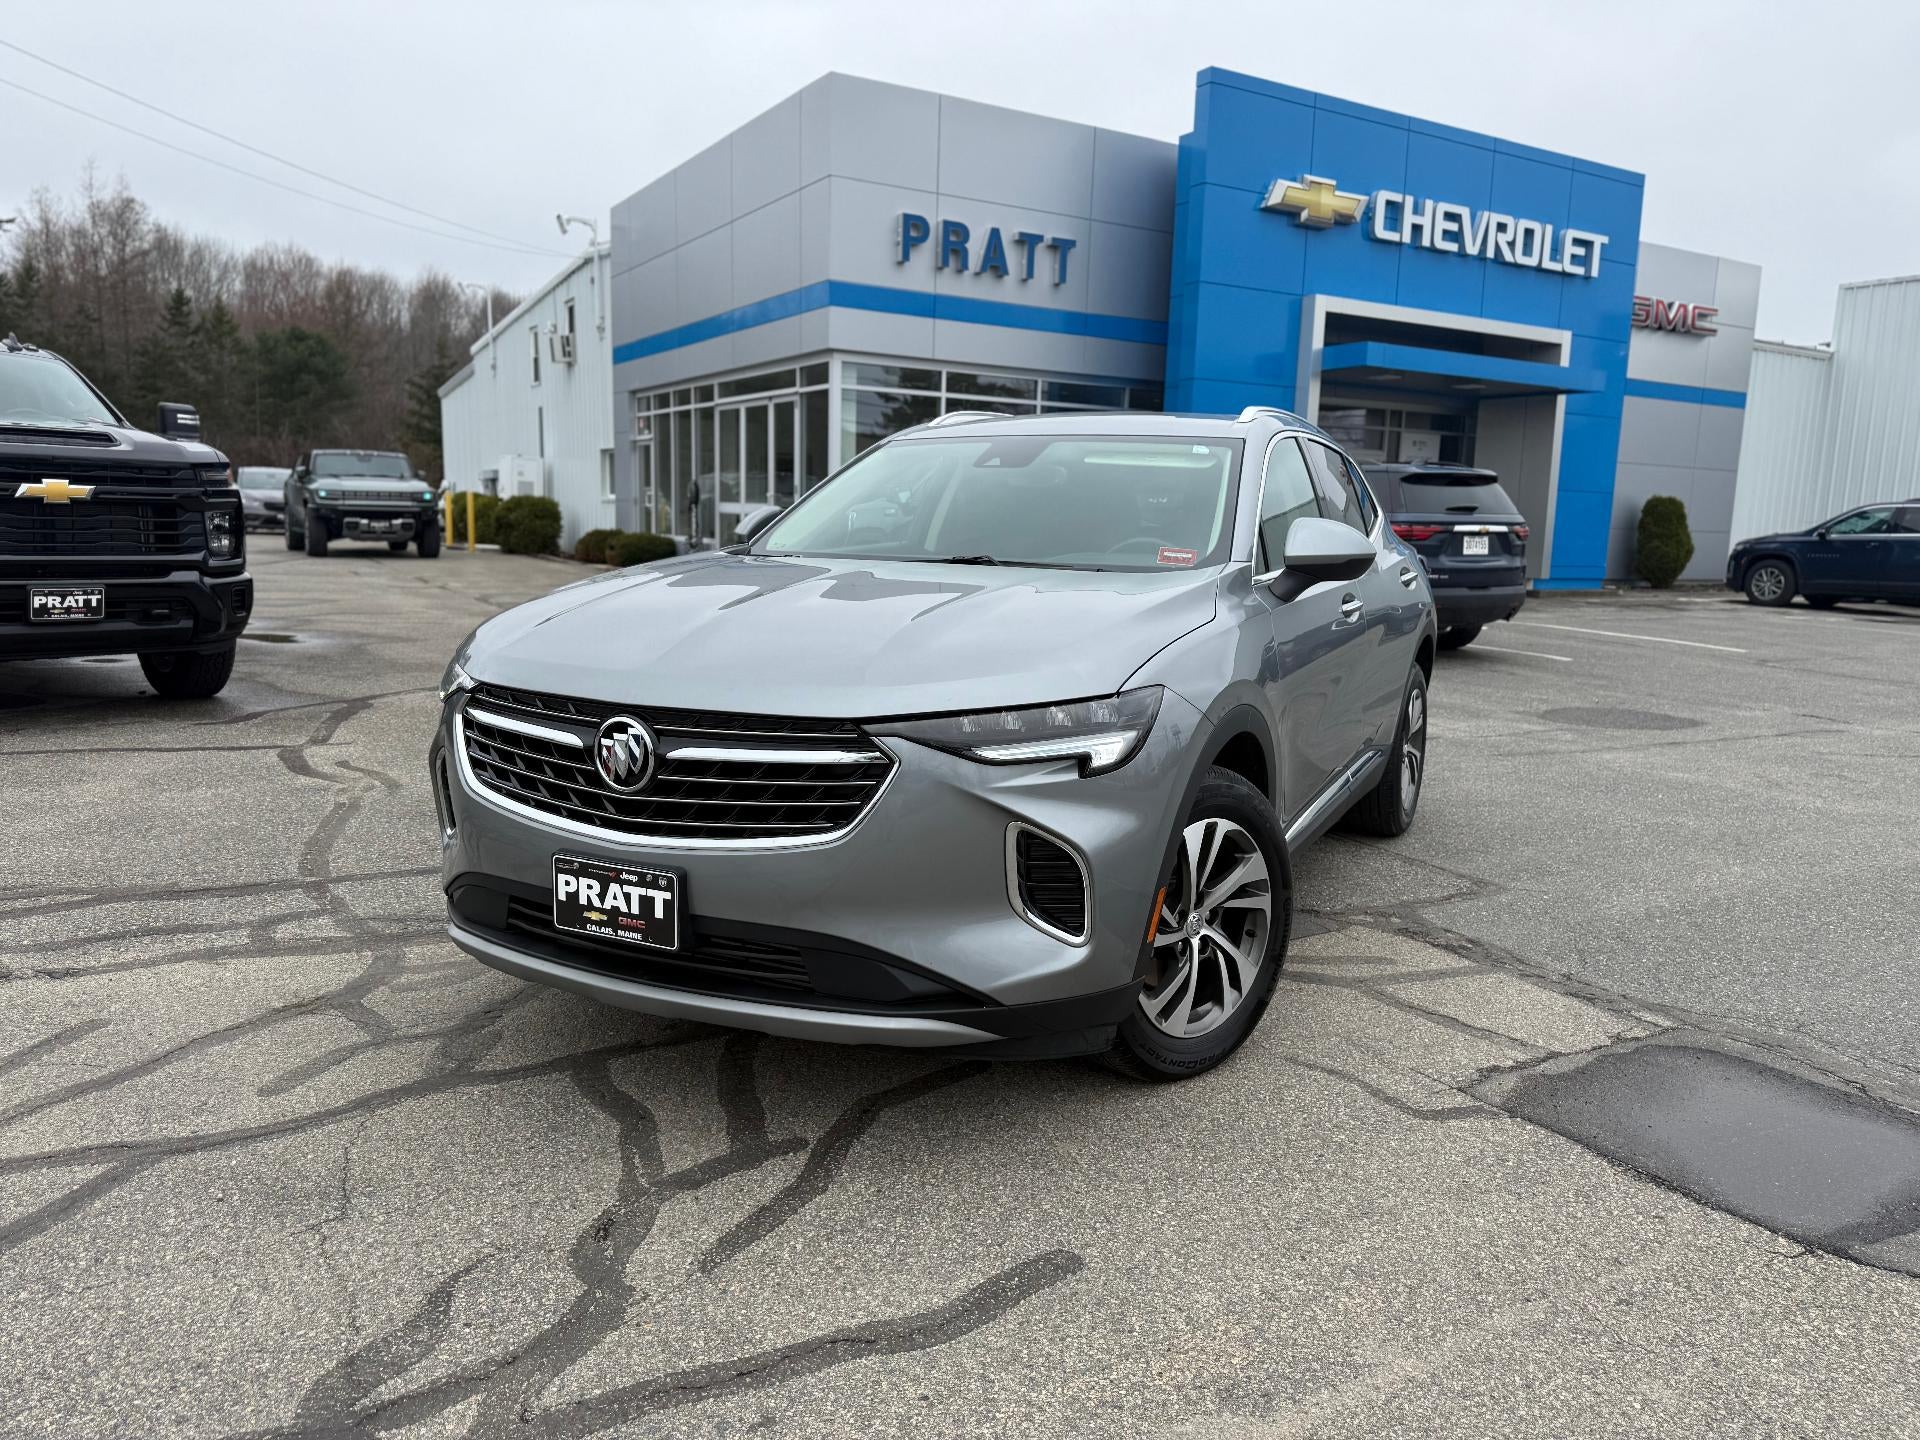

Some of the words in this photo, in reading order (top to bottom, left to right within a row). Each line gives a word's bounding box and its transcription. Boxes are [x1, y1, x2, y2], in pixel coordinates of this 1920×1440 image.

[1373, 189, 1609, 278] CHEVROLET
[897, 212, 1077, 286] PRATT
[1632, 295, 1719, 337] GMC
[33, 594, 102, 608] PRATT
[619, 871, 639, 883] Jeep
[557, 873, 671, 919] PRATT
[617, 929, 643, 941] MAINE
[618, 916, 646, 929] GMC
